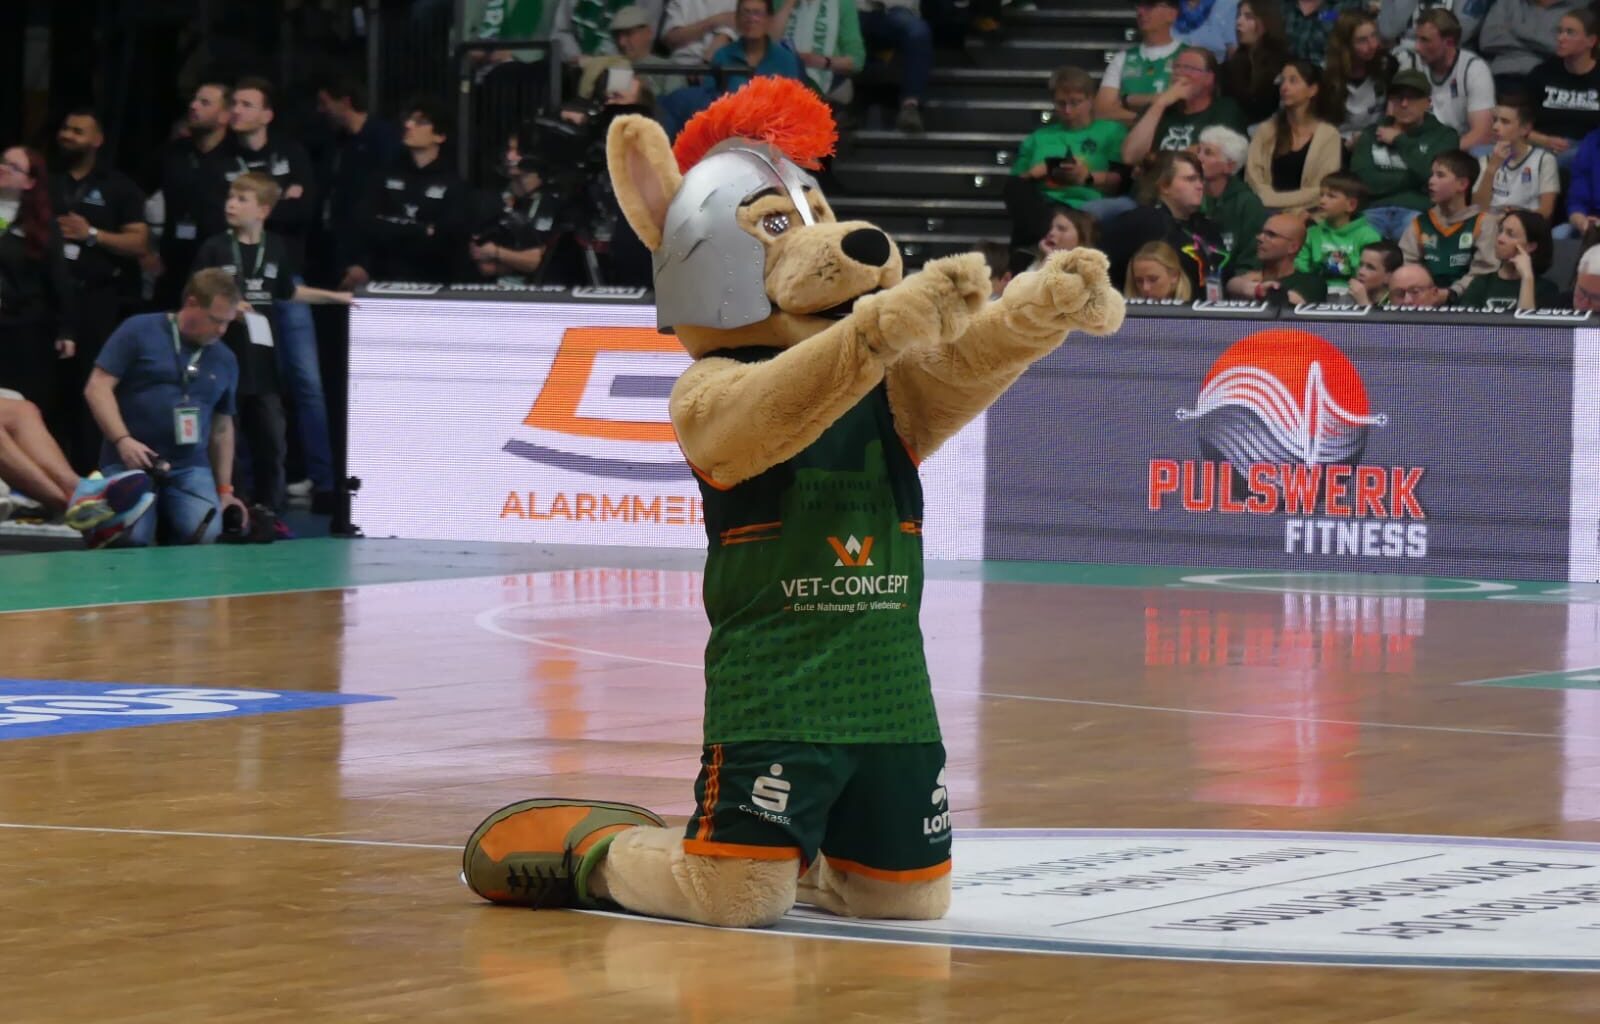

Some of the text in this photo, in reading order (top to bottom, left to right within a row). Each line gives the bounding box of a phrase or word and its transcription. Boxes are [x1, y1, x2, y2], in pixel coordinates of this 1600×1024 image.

[1148, 459, 1426, 519] PULSWERK
[1285, 519, 1428, 558] FITNESS
[781, 575, 909, 597] VET-CONCEPT
[793, 603, 815, 612] Gute
[817, 602, 855, 613] Nahrung
[856, 601, 869, 611] für
